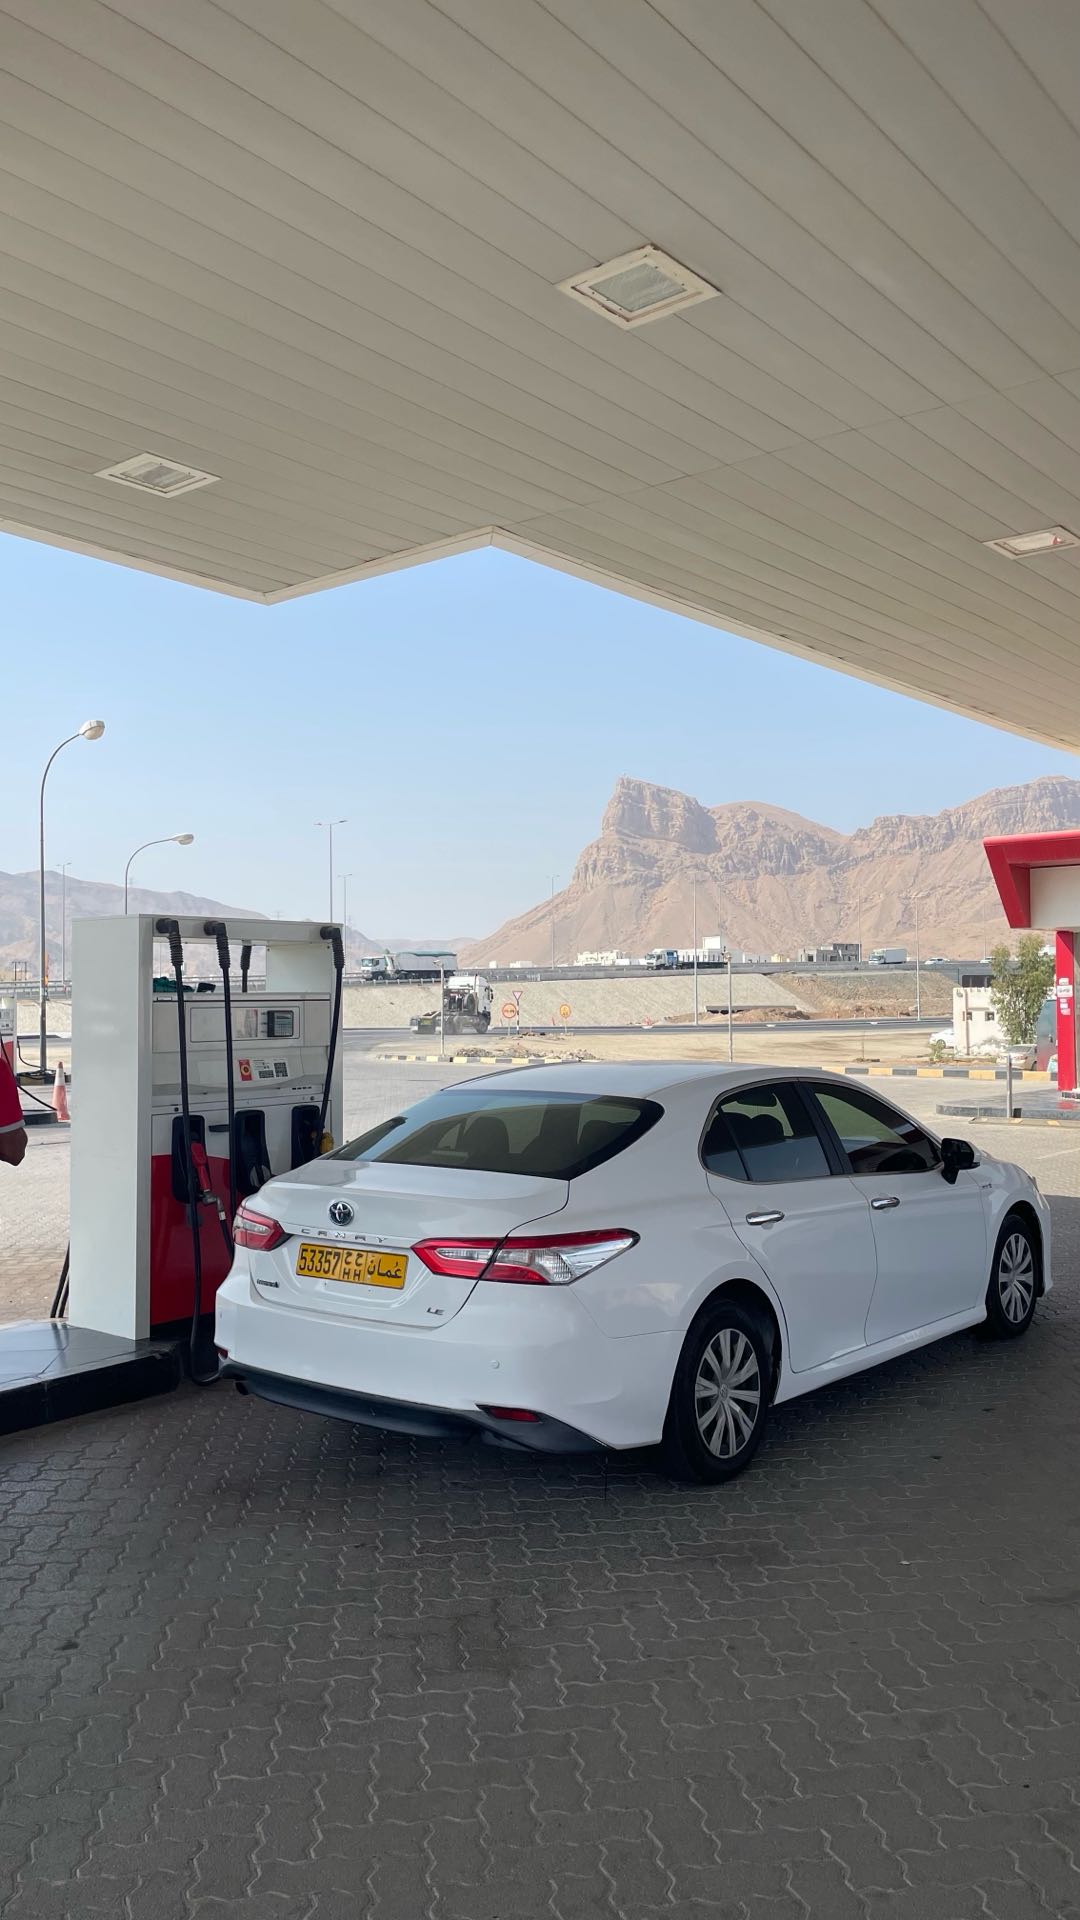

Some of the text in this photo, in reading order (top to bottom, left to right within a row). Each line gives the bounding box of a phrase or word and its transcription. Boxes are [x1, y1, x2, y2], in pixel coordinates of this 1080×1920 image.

[301, 1228, 388, 1243] CAMRY
[299, 1248, 341, 1275] 53357
[427, 1307, 445, 1316] LE
